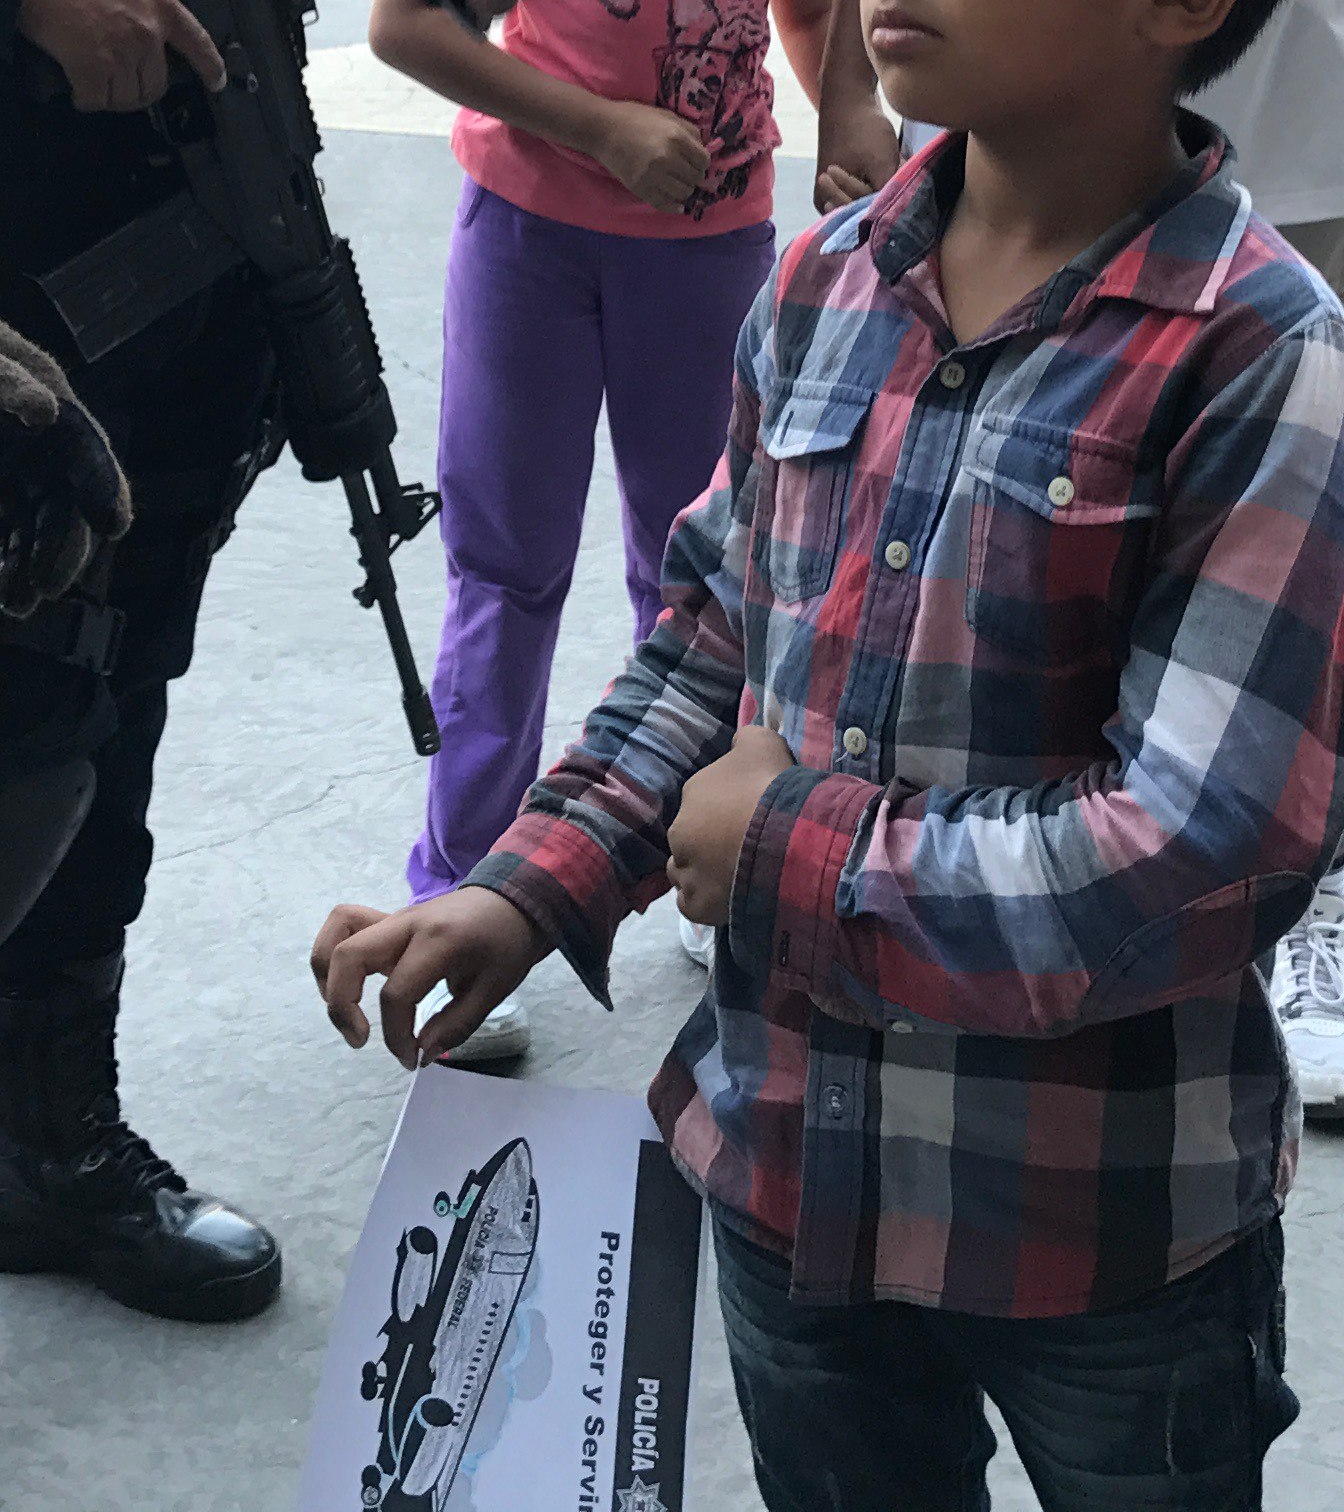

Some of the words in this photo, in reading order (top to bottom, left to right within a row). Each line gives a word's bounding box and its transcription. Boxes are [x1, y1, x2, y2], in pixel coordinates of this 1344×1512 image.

[447, 1276, 473, 1330] FEDERAL
[587, 1230, 621, 1376] Proteger
[582, 1384, 603, 1405] y
[631, 1377, 660, 1472] POLICÍA
